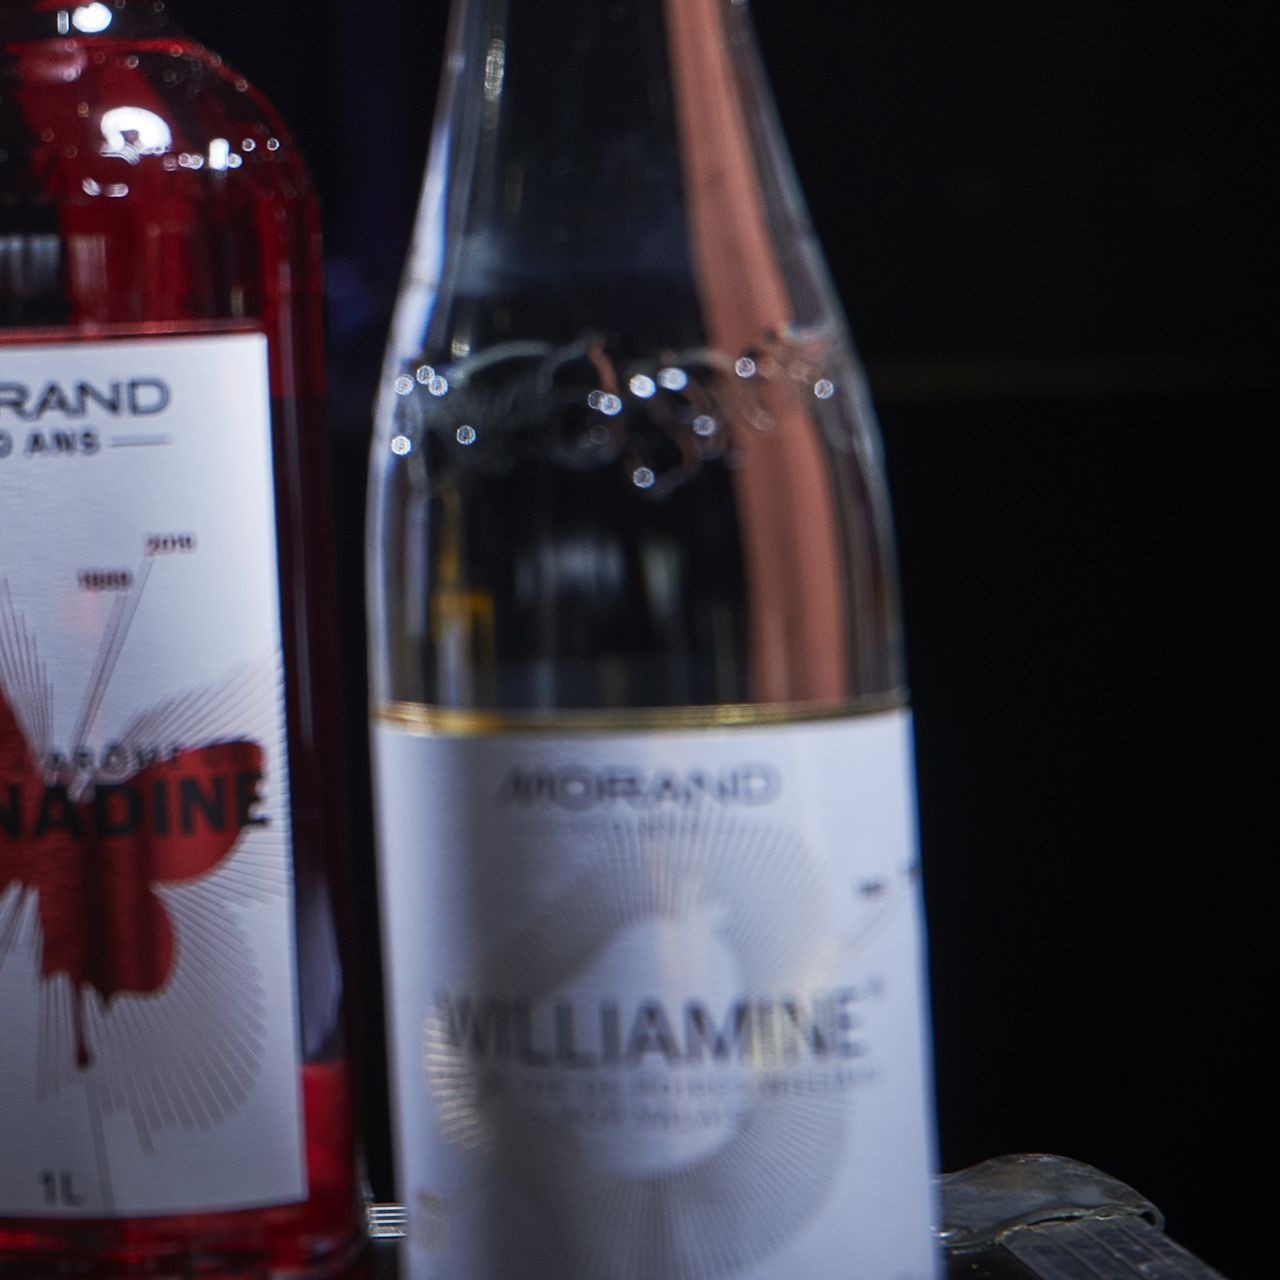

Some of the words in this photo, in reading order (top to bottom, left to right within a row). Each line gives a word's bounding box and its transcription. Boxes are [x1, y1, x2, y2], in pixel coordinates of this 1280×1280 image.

[26, 426, 102, 456] ANS
[495, 762, 783, 811] MORAND
[40, 1169, 82, 1207] 1L
